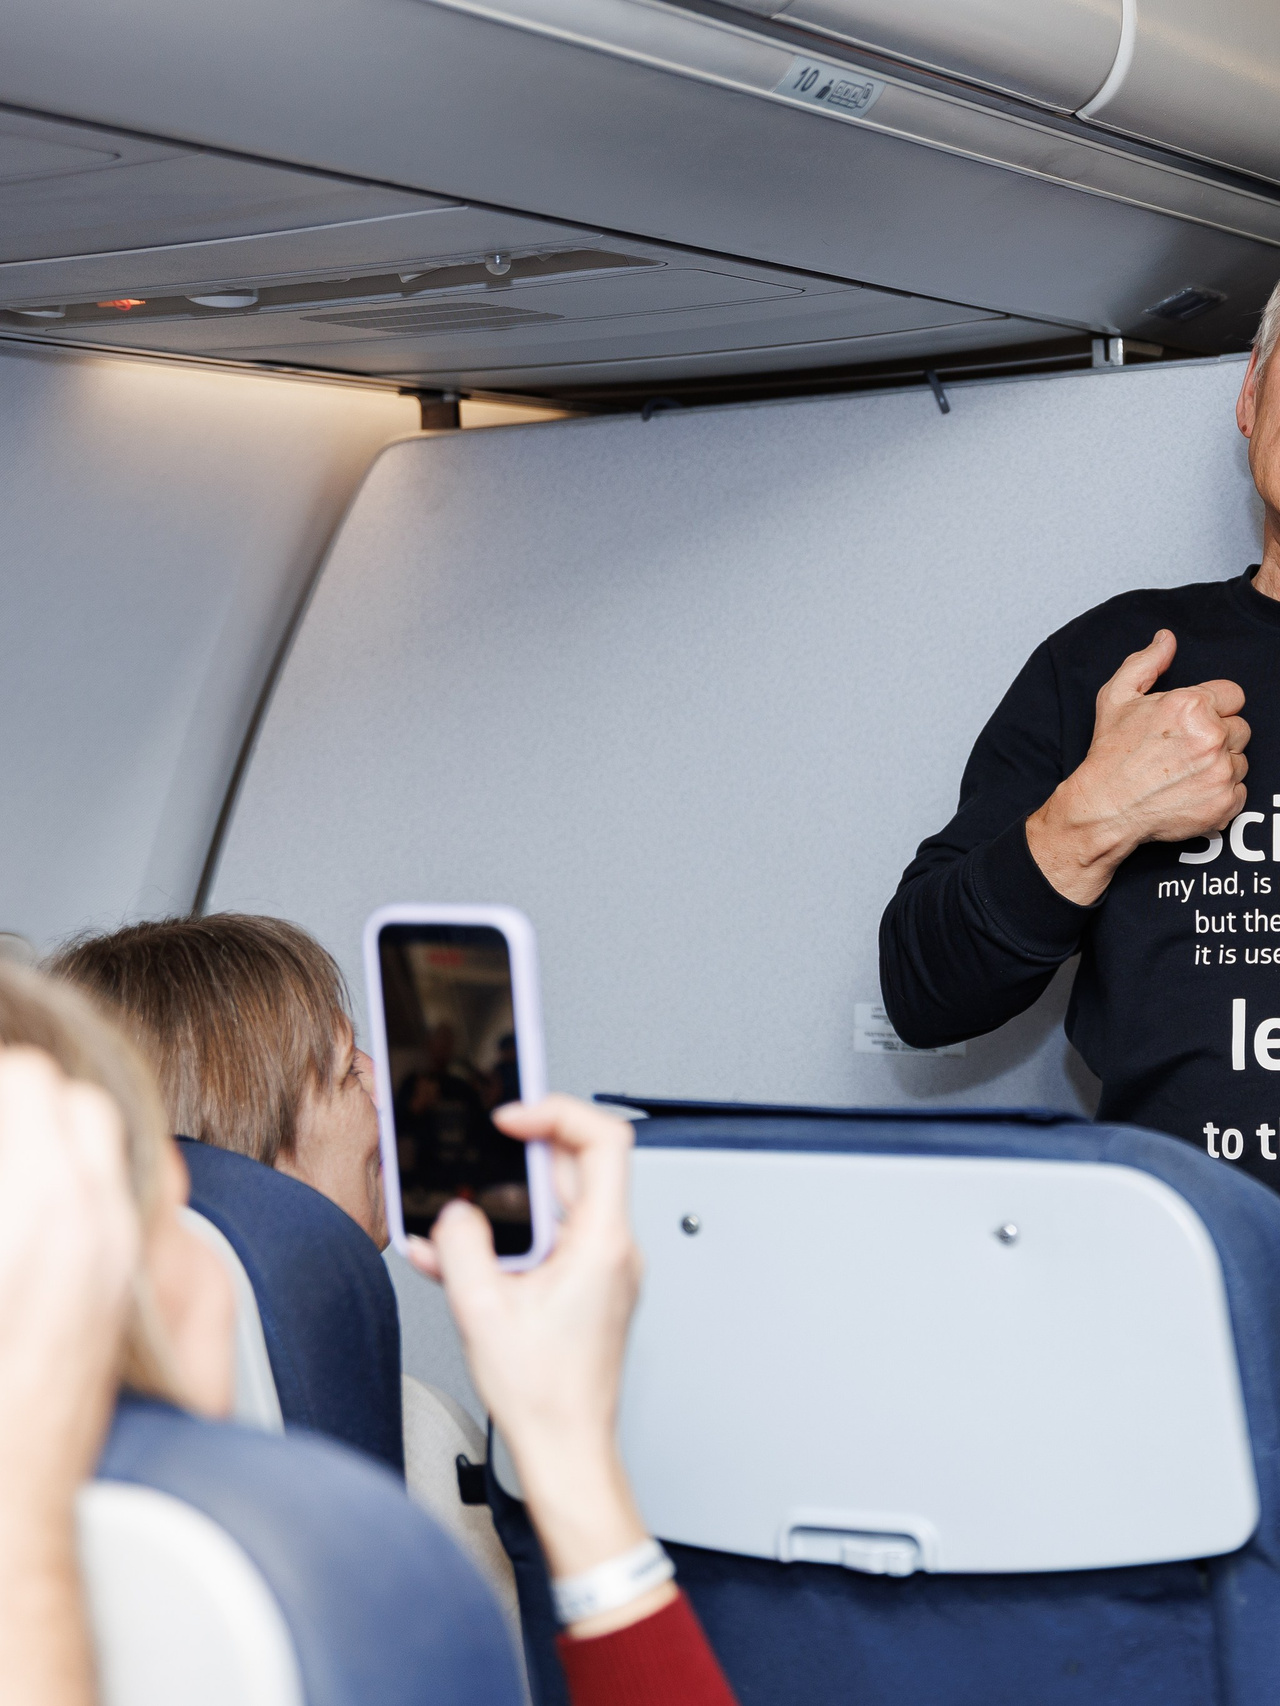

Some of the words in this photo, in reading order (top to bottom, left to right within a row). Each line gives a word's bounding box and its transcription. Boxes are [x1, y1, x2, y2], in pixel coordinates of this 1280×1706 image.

[793, 67, 820, 92] 10
[1159, 879, 1195, 903] my
[1203, 871, 1244, 896] lad,
[1254, 872, 1271, 893] is
[1196, 910, 1236, 933] but
[1195, 945, 1211, 965] it
[1219, 944, 1236, 964] is
[1203, 1122, 1243, 1159] to
